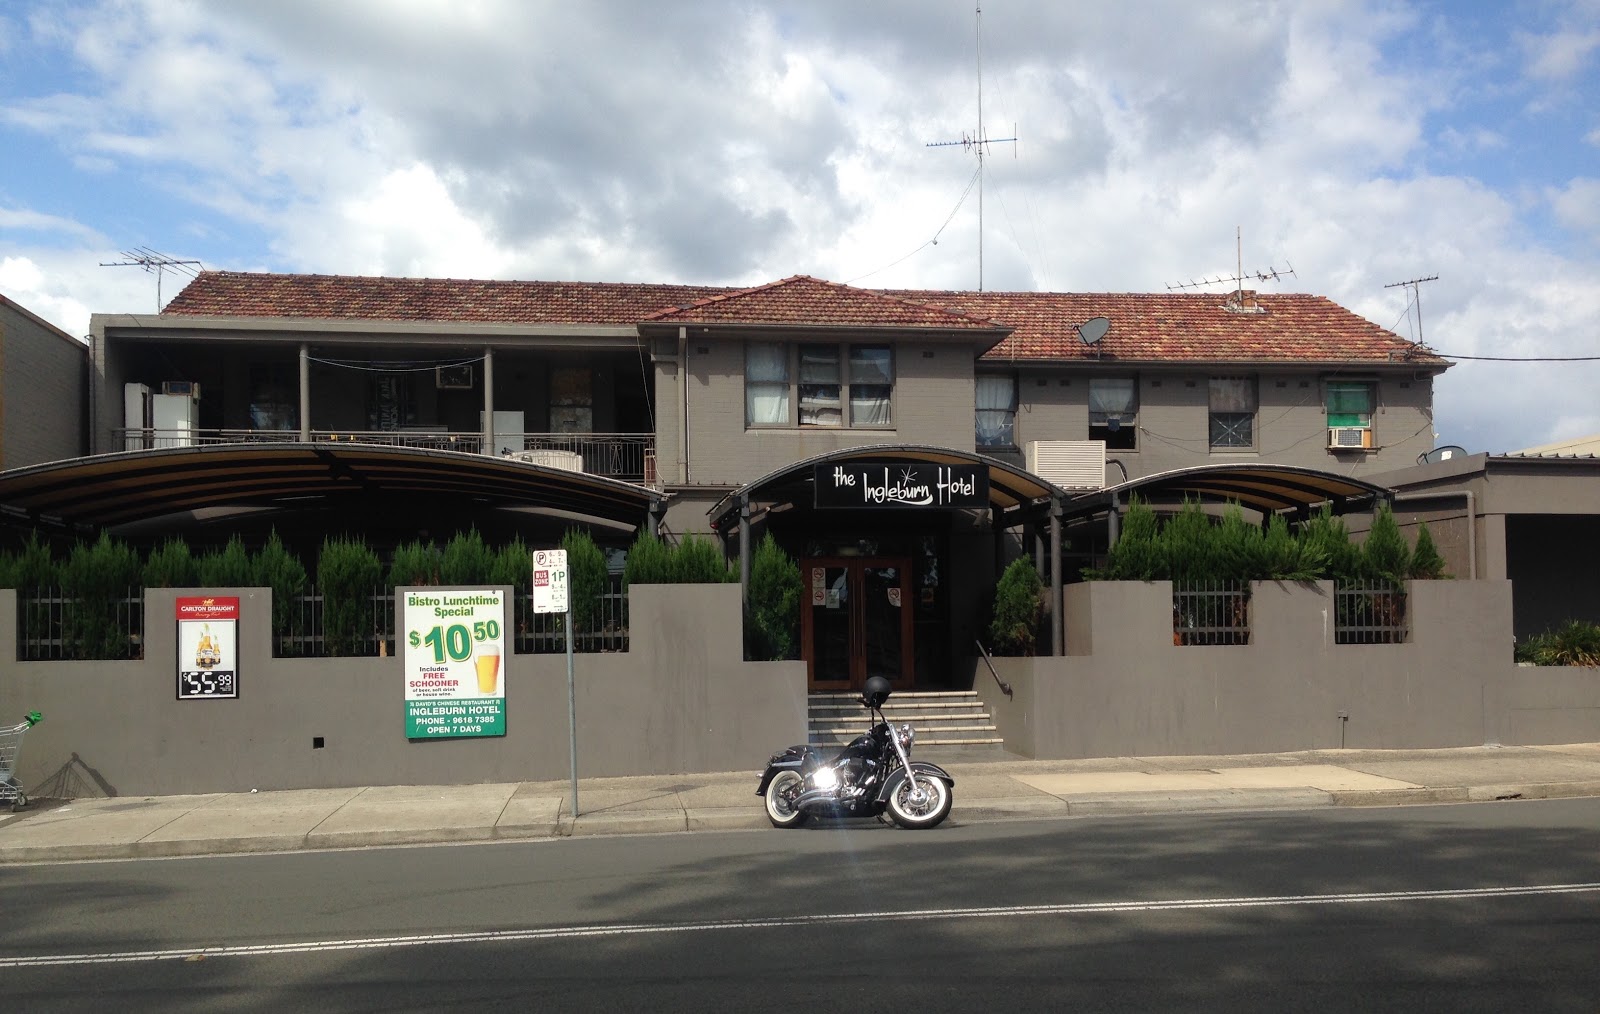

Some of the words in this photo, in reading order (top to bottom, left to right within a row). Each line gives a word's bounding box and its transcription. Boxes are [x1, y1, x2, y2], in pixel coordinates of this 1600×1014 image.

[833, 465, 856, 487] the
[863, 467, 931, 504] Ingleburn
[936, 466, 975, 505] Hotel
[551, 571, 565, 582] 1P
[408, 597, 440, 606] Bistro
[443, 595, 500, 605] Lunchtime
[434, 606, 474, 619] Special
[409, 707, 466, 716] INGLEBURN
[468, 706, 501, 714] HOTEL
[415, 717, 445, 725] PHONE
[452, 716, 473, 724] 9618
[427, 726, 450, 734] OPEN
